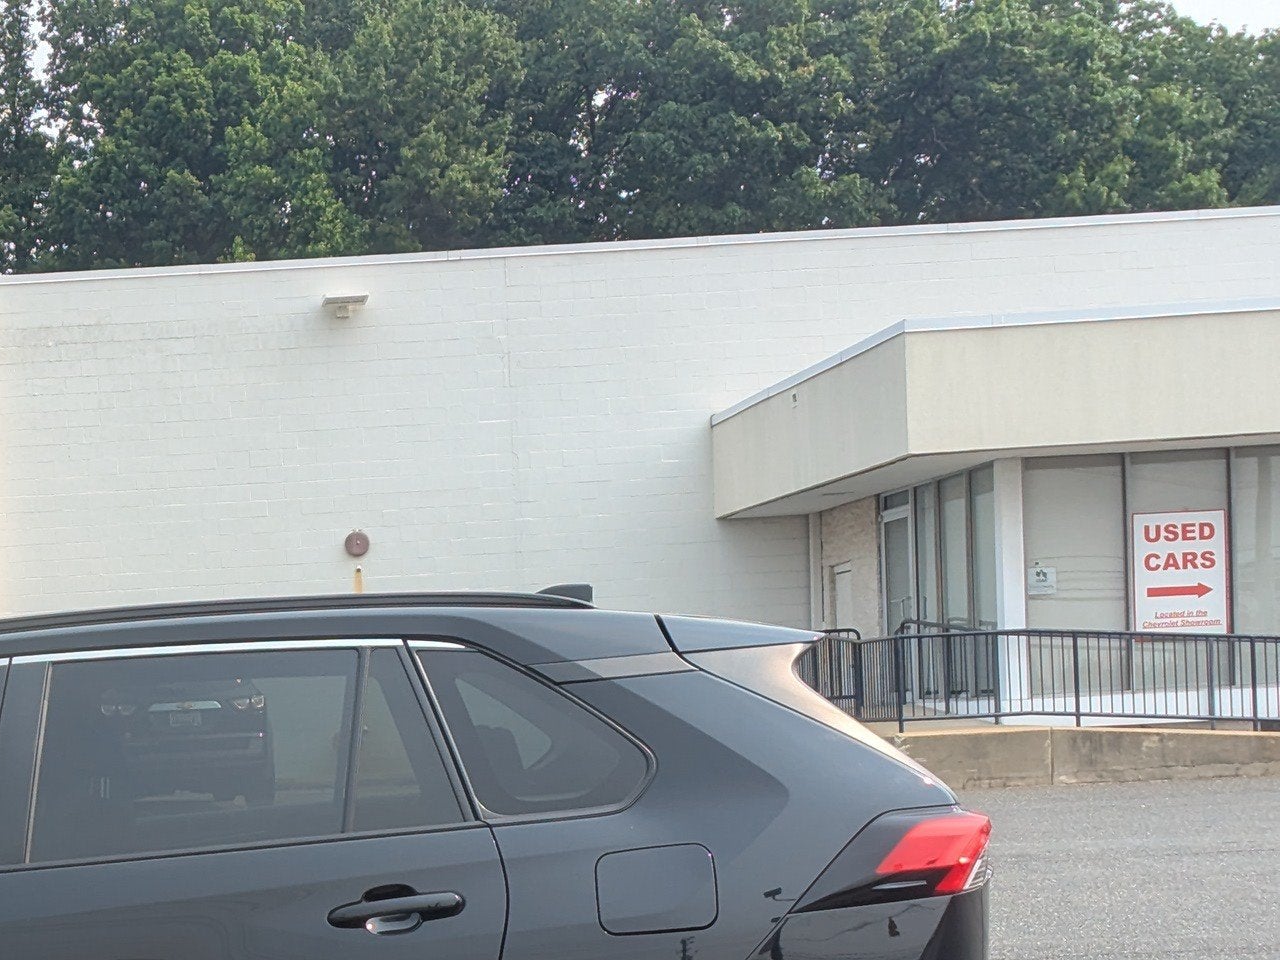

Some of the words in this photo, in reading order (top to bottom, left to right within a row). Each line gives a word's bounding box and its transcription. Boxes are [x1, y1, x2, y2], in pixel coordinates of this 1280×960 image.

[1143, 522, 1216, 543] USED
[1143, 550, 1217, 572] CARS
[1155, 610, 1185, 619] Located
[1186, 609, 1194, 618] in
[1195, 609, 1208, 617] the
[1142, 620, 1179, 629] Chevrolet
